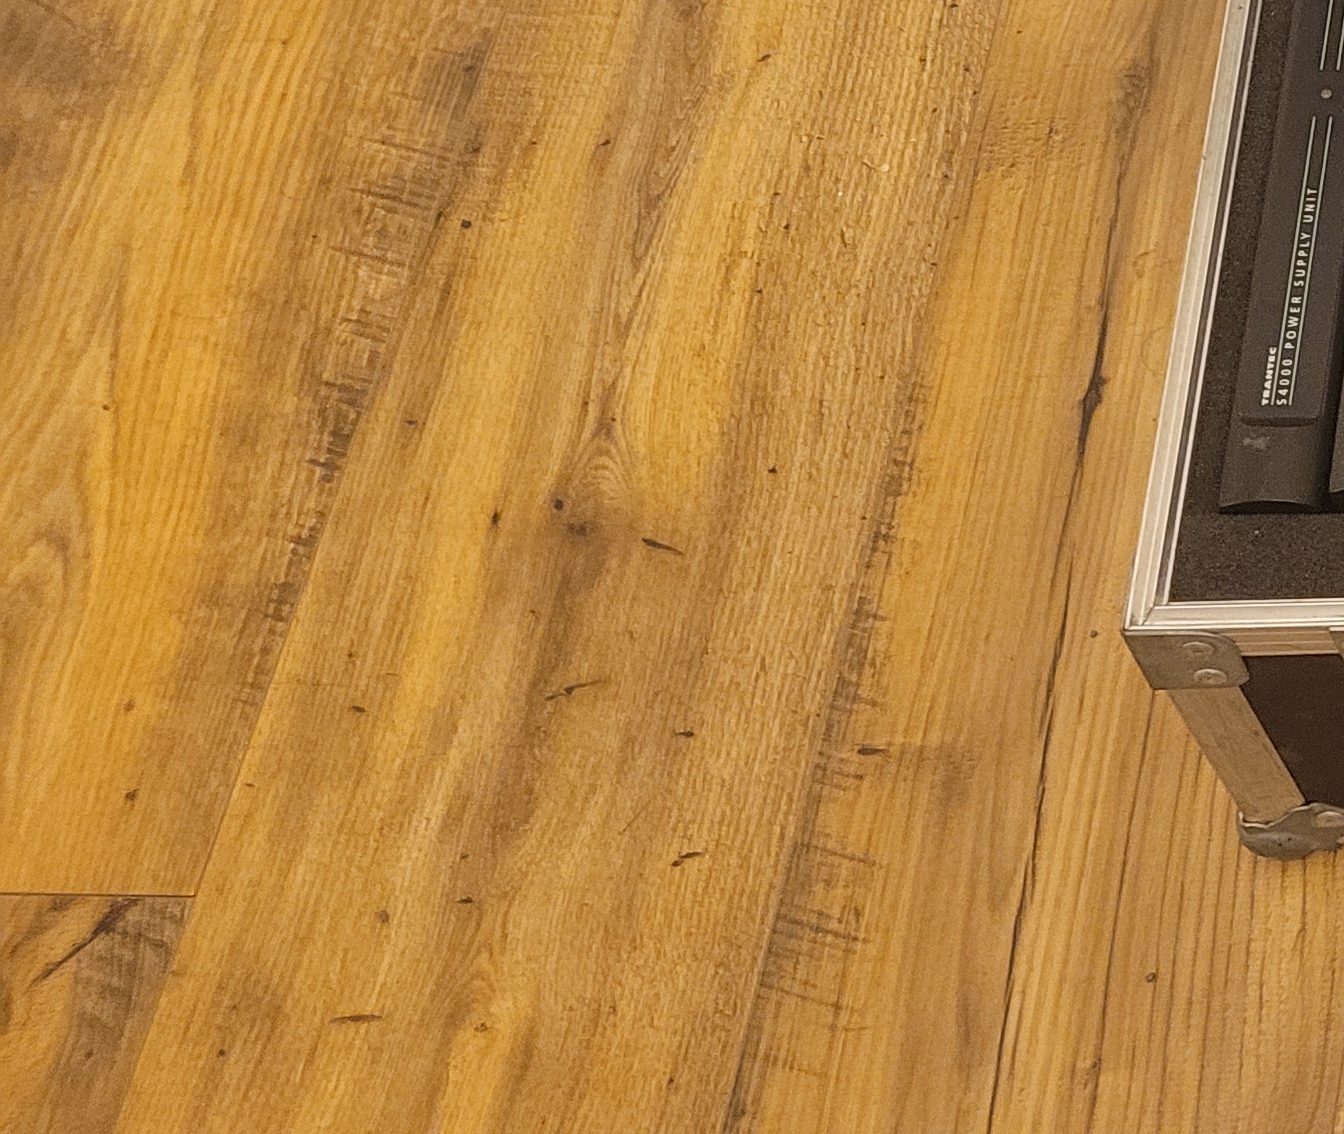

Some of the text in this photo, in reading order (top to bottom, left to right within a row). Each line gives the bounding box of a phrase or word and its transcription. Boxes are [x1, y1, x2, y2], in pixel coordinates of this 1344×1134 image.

[1276, 188, 1317, 405] S4000 POWER SUPPLY UNIT
[1261, 346, 1276, 405] TRANTEC
